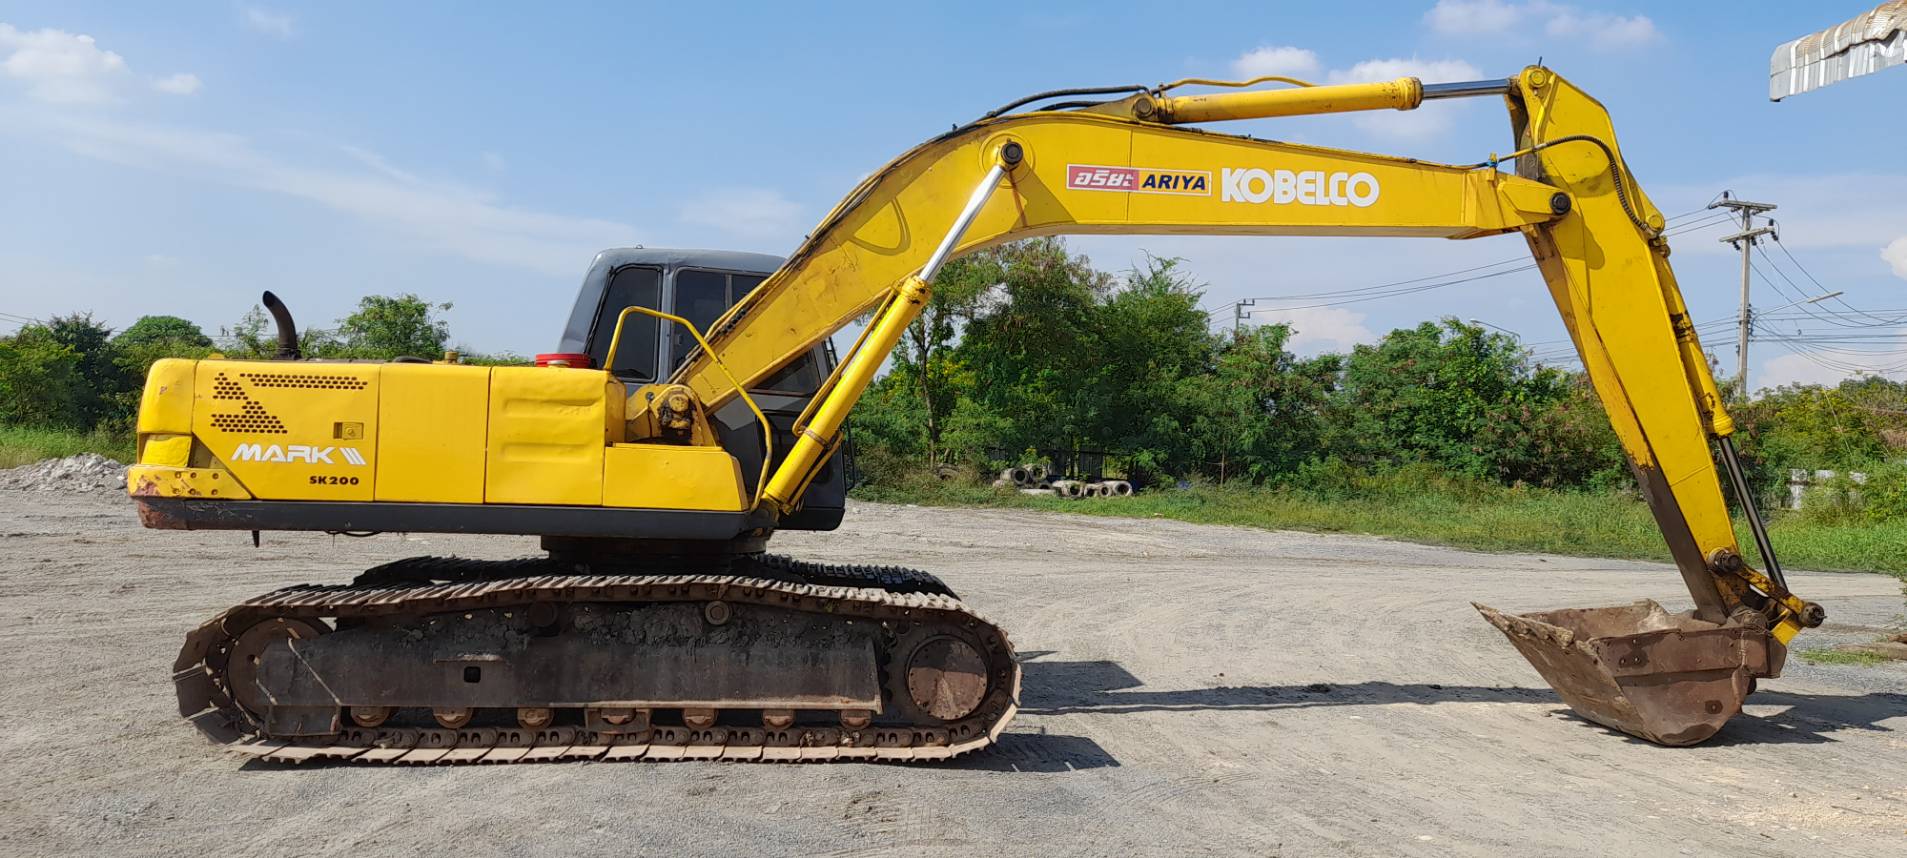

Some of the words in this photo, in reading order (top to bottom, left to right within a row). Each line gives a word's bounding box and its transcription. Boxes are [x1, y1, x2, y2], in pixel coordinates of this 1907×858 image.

[1074, 169, 1133, 187] อริยะ
[1141, 173, 1207, 190] ARIYA
[1221, 167, 1380, 207] KOBELCO
[231, 443, 336, 464] MARK
